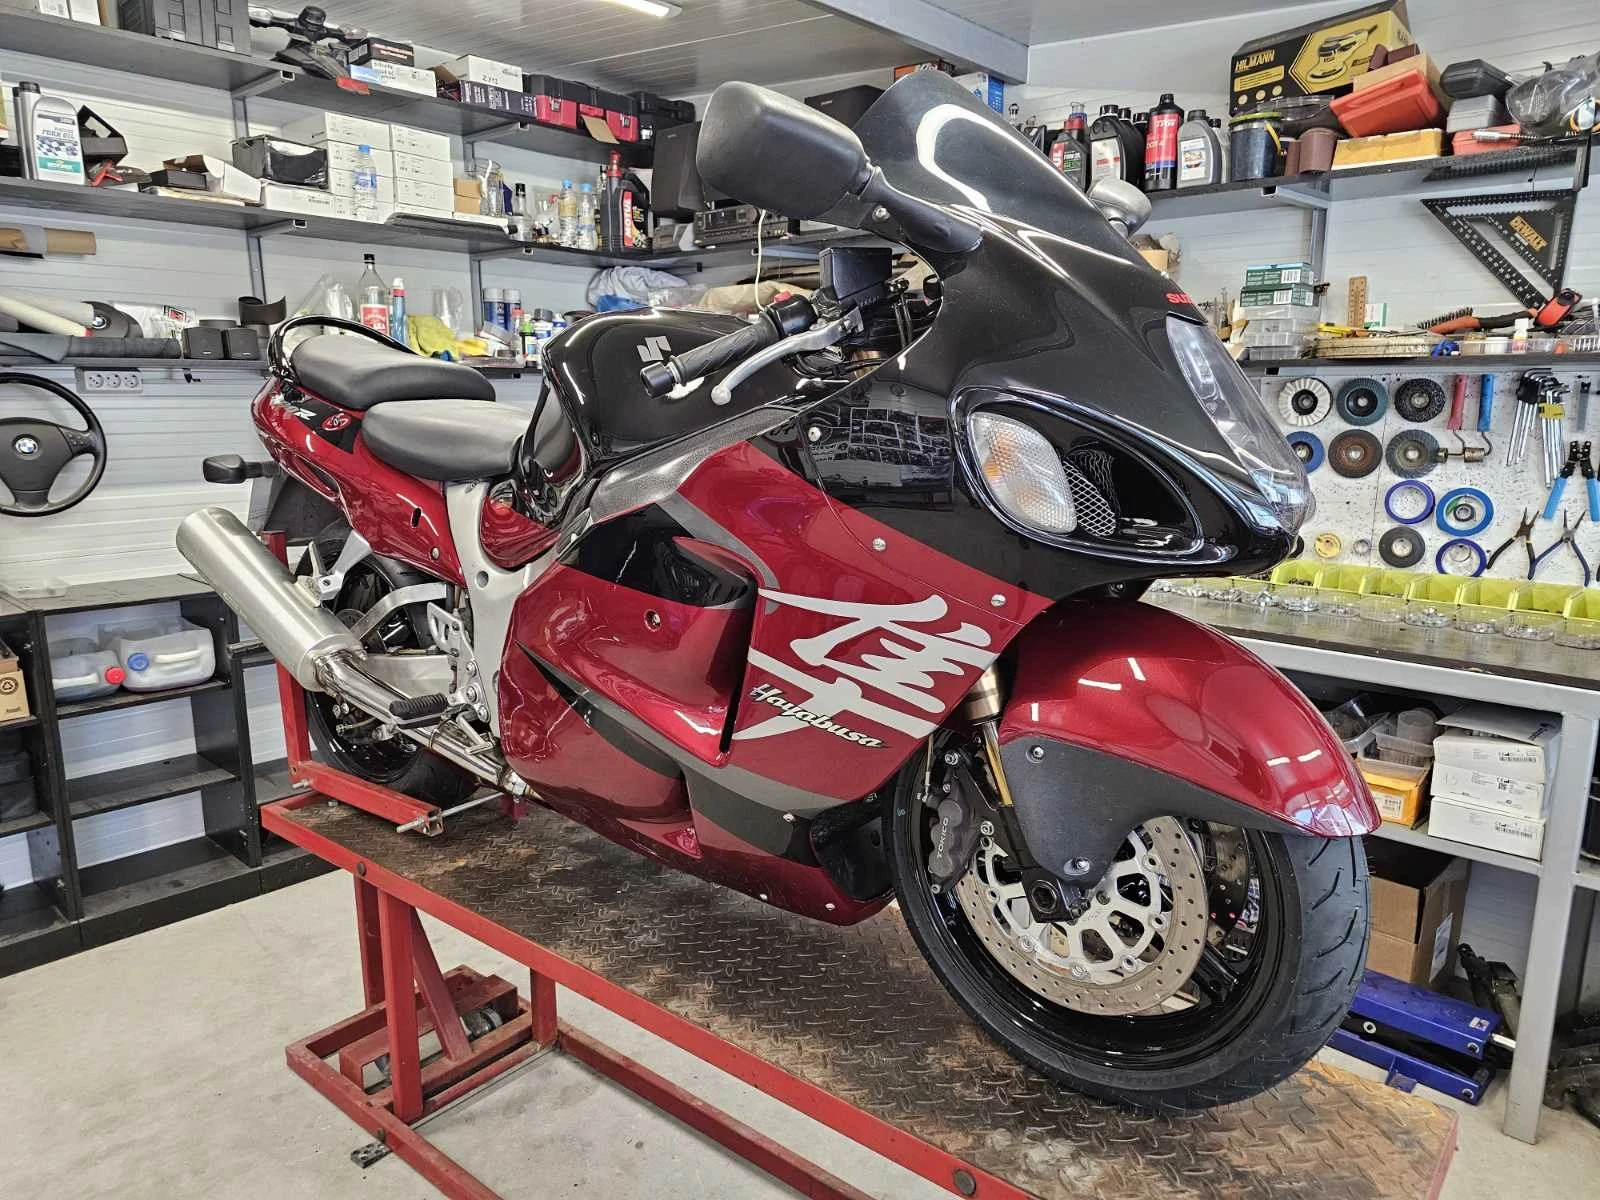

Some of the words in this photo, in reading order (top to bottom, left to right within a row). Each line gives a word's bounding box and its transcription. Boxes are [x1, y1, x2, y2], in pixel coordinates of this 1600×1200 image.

[624, 200, 632, 238] MOTUL
[750, 684, 885, 748] Hayabusa
[937, 818, 948, 859] TOKICO
